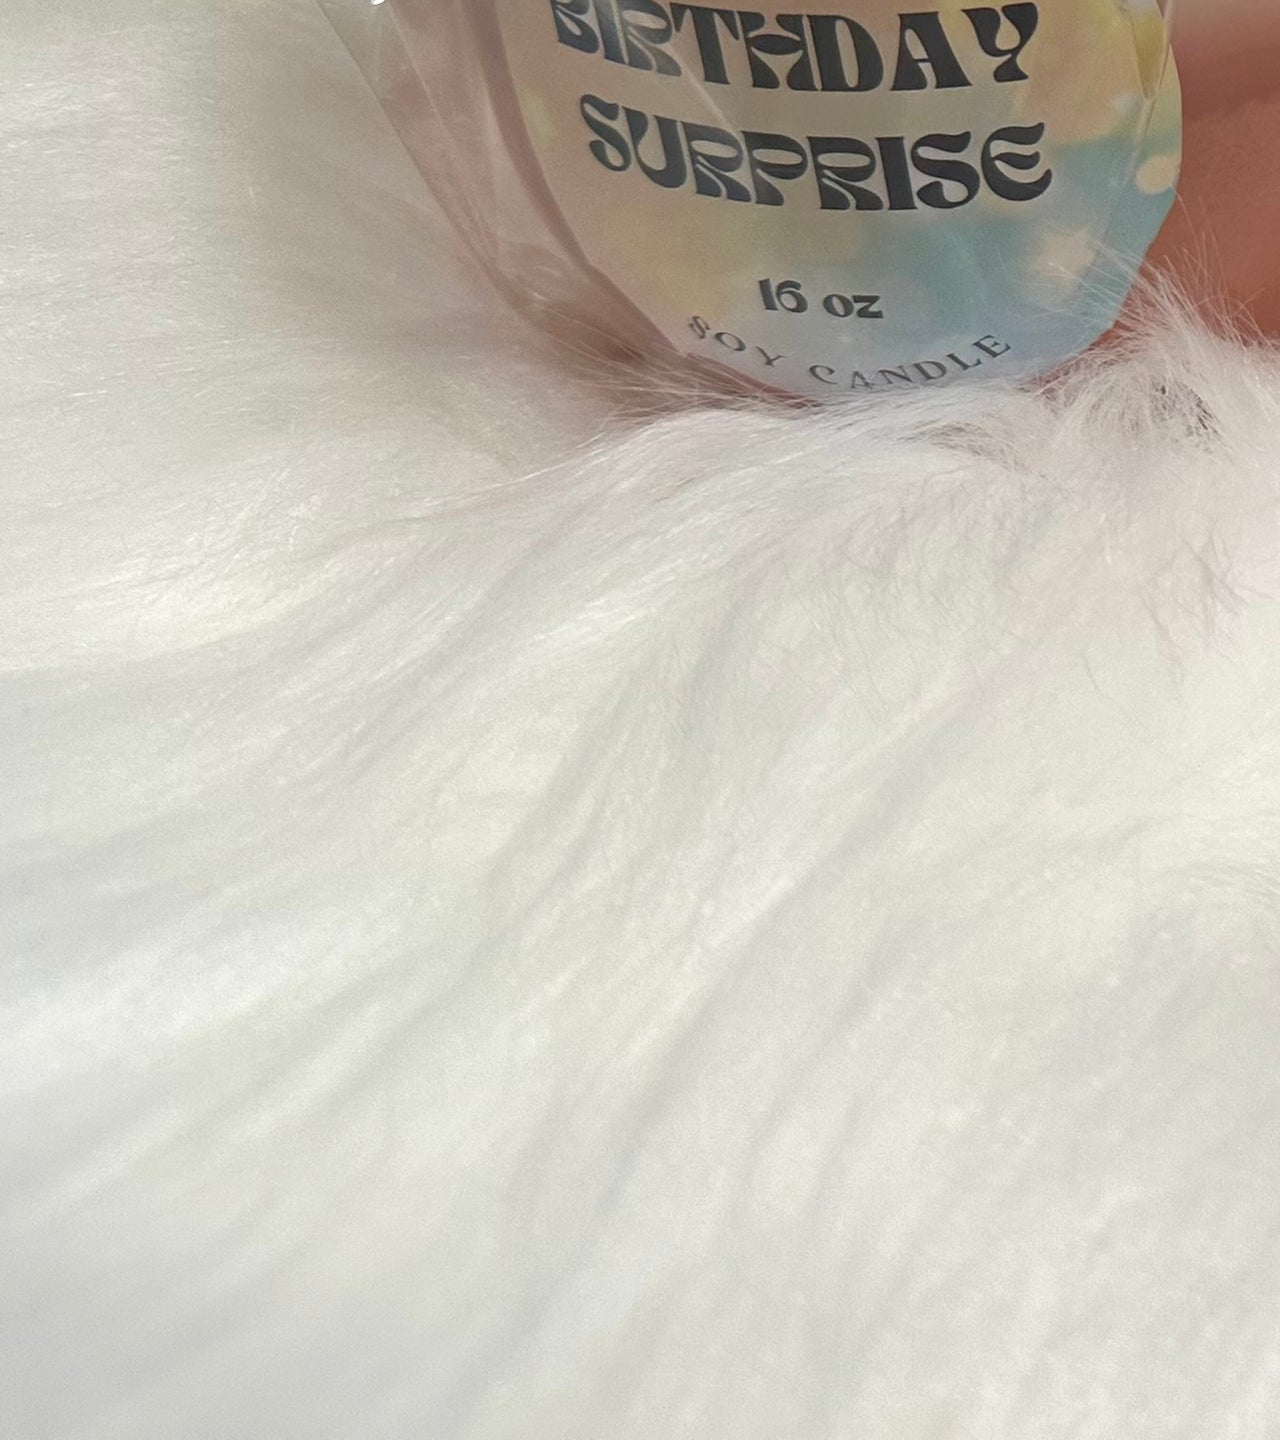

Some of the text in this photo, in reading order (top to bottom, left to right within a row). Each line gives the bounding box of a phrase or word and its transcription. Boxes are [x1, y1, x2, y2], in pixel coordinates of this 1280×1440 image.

[579, 94, 1054, 211] SURPRISE
[757, 278, 884, 319] 16 oz
[687, 316, 1012, 390] SOY CANDLE
